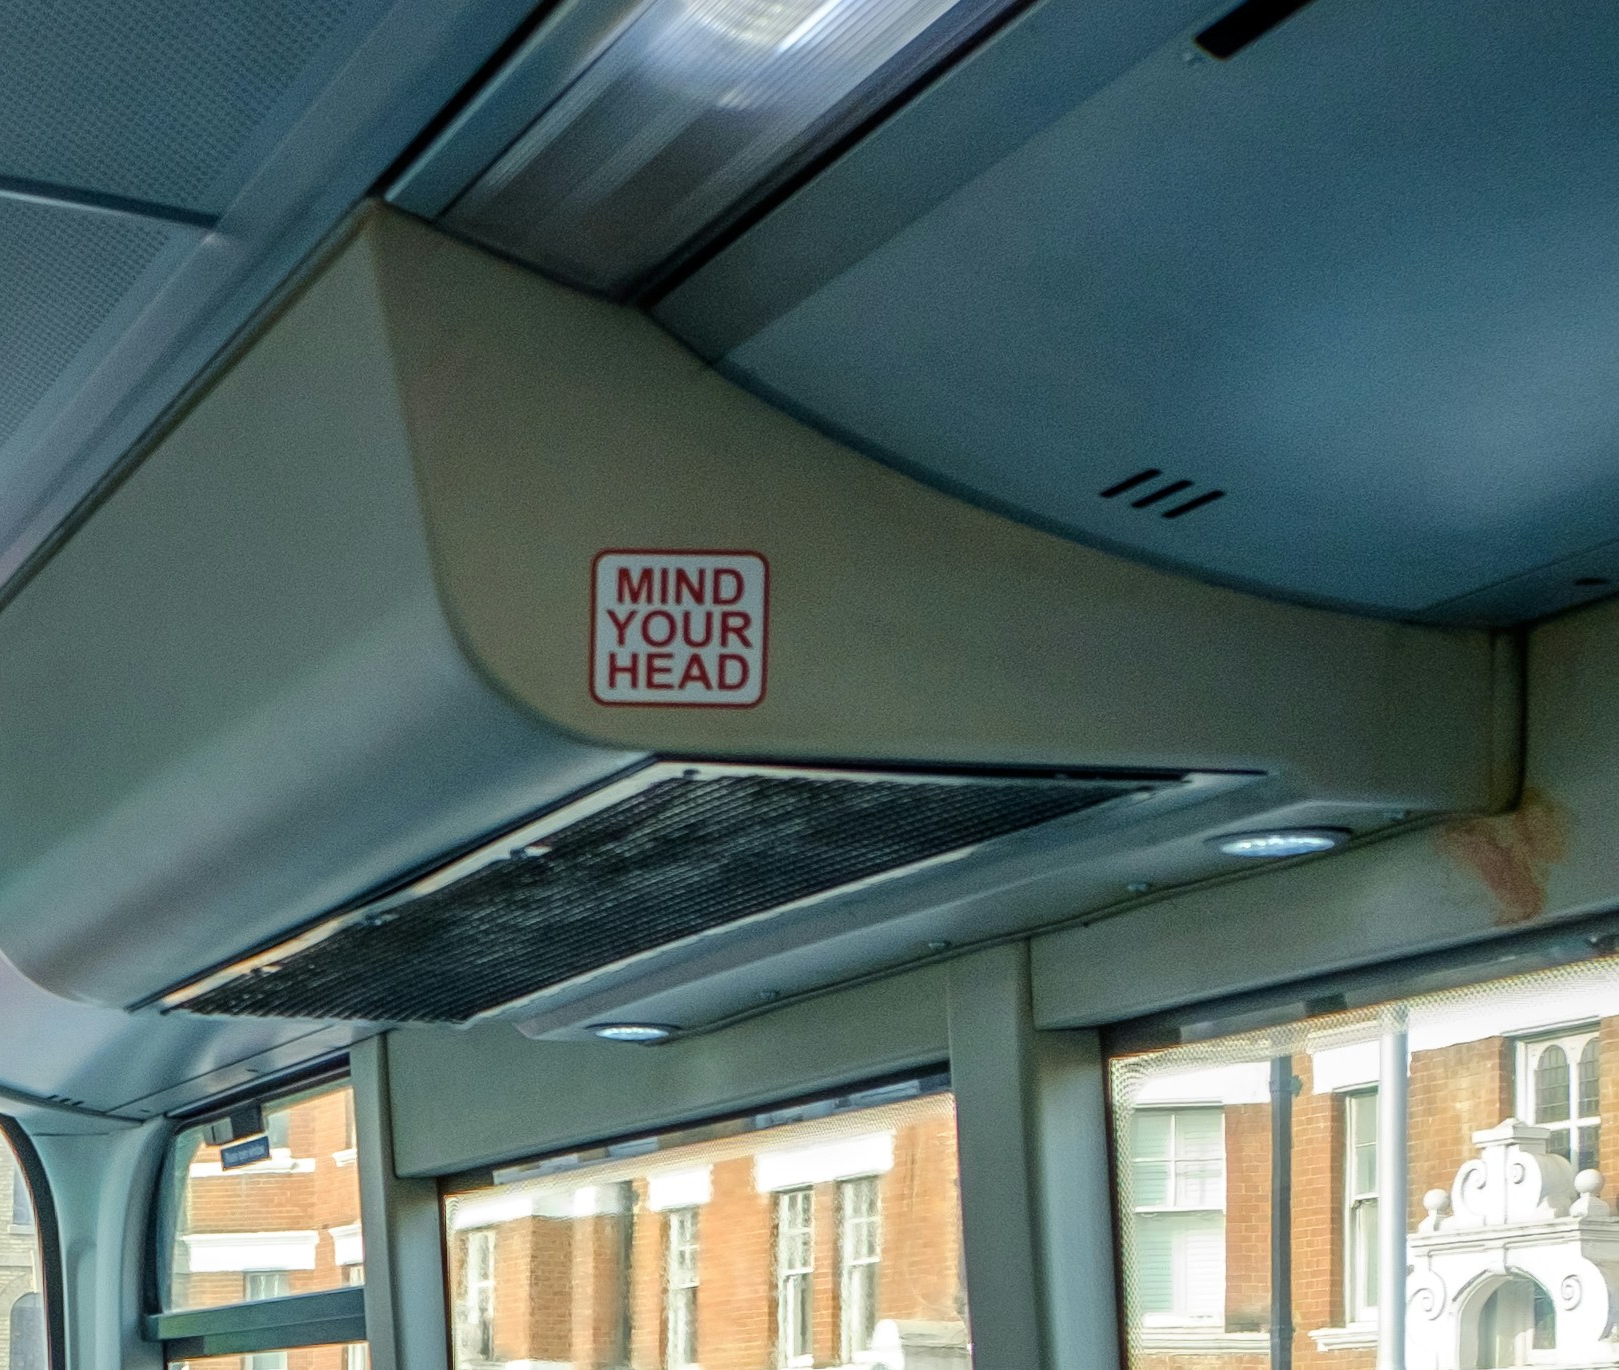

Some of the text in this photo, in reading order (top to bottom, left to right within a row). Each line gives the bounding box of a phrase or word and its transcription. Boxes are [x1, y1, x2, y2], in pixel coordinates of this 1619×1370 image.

[616, 566, 745, 606] MIND
[606, 609, 753, 649] YOUR
[608, 651, 750, 691] HEAD
